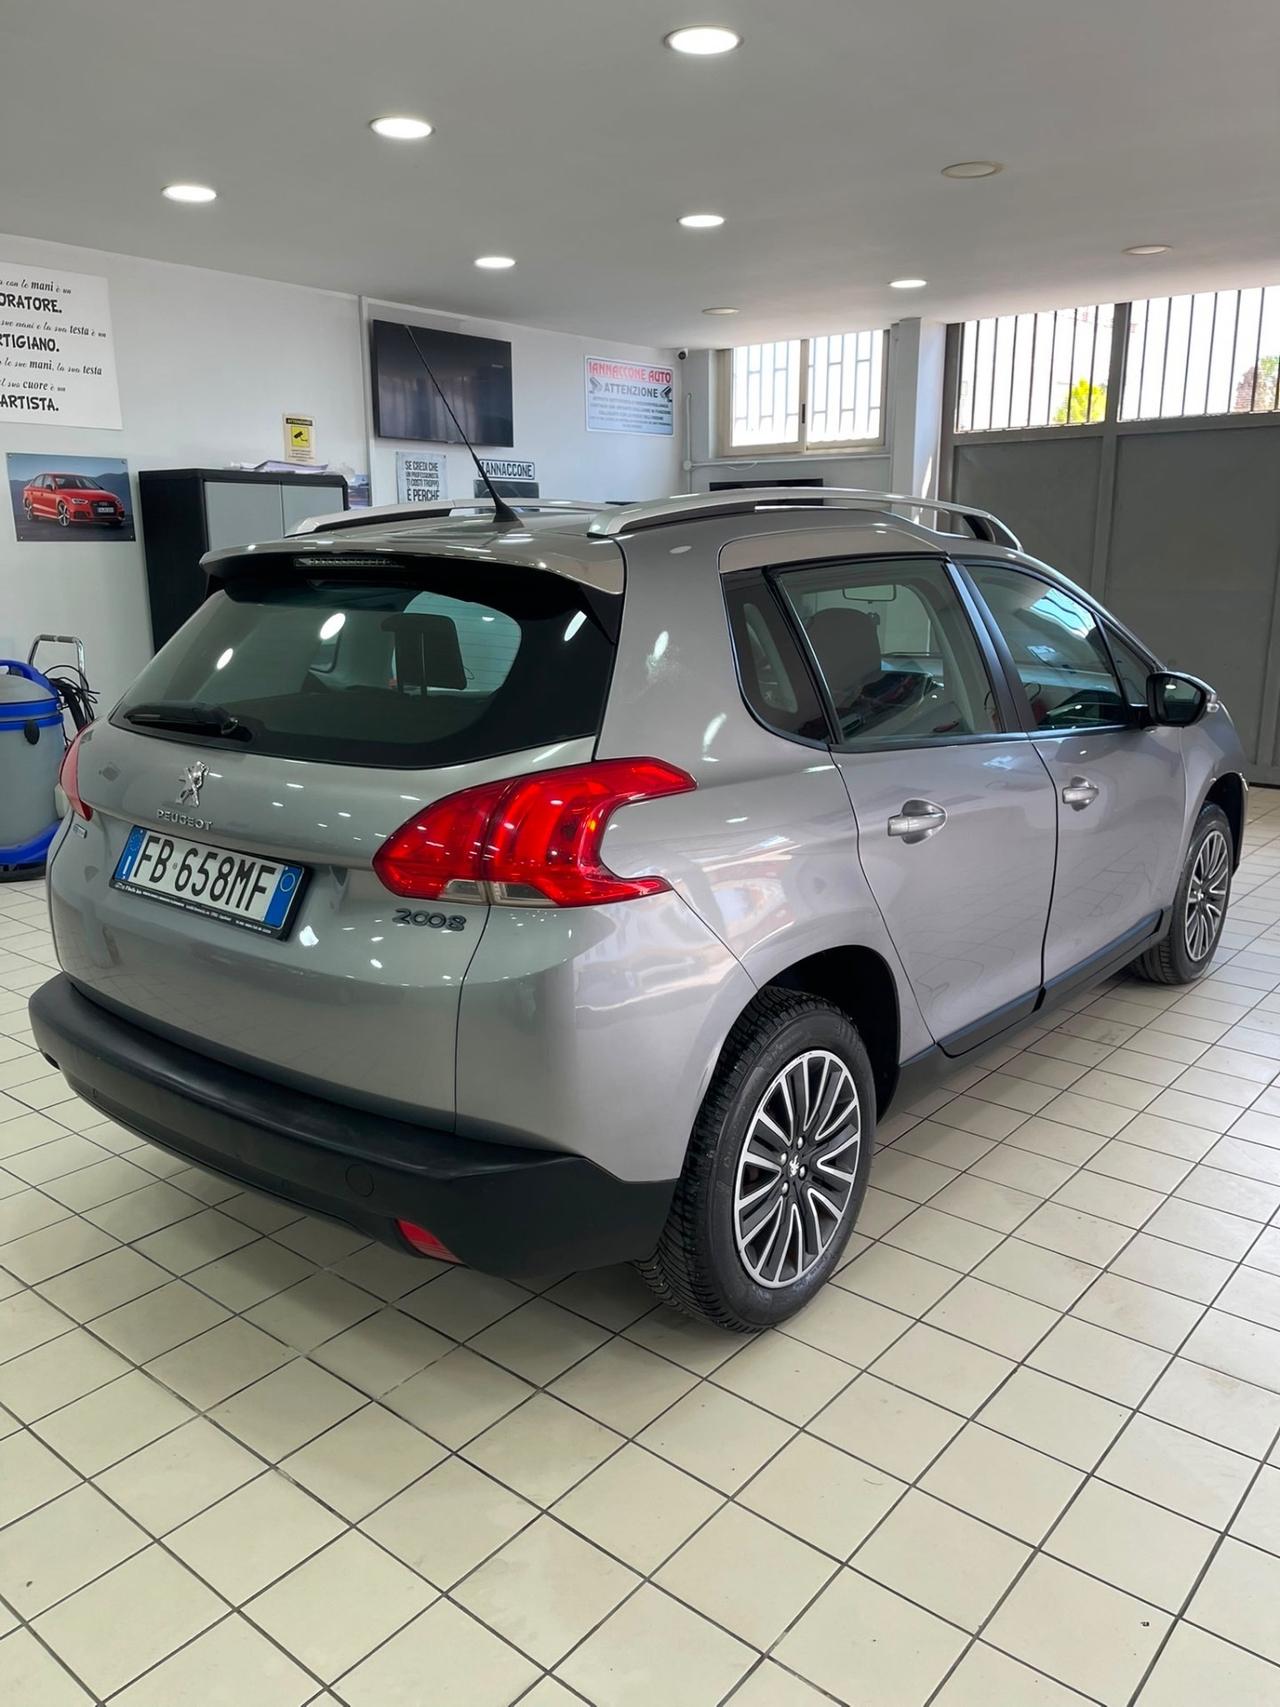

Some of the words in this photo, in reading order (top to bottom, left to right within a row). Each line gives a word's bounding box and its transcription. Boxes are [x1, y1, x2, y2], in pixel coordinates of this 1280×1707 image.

[31, 281, 54, 292] mani
[0, 292, 62, 313] ORATORE.
[69, 325, 89, 336] testa
[29, 360, 54, 371] mani,
[83, 365, 102, 375] testa
[648, 370, 671, 384] AUTO
[22, 381, 48, 391] cuore
[604, 383, 658, 398] ATTENZIONE
[0, 394, 59, 412] ARTISTA.
[405, 460, 412, 470] SE
[428, 462, 438, 471] CHE
[156, 809, 214, 831] PEUGEOT
[133, 835, 175, 883] FB
[174, 847, 278, 912] 658MF
[391, 907, 467, 932] 2008
